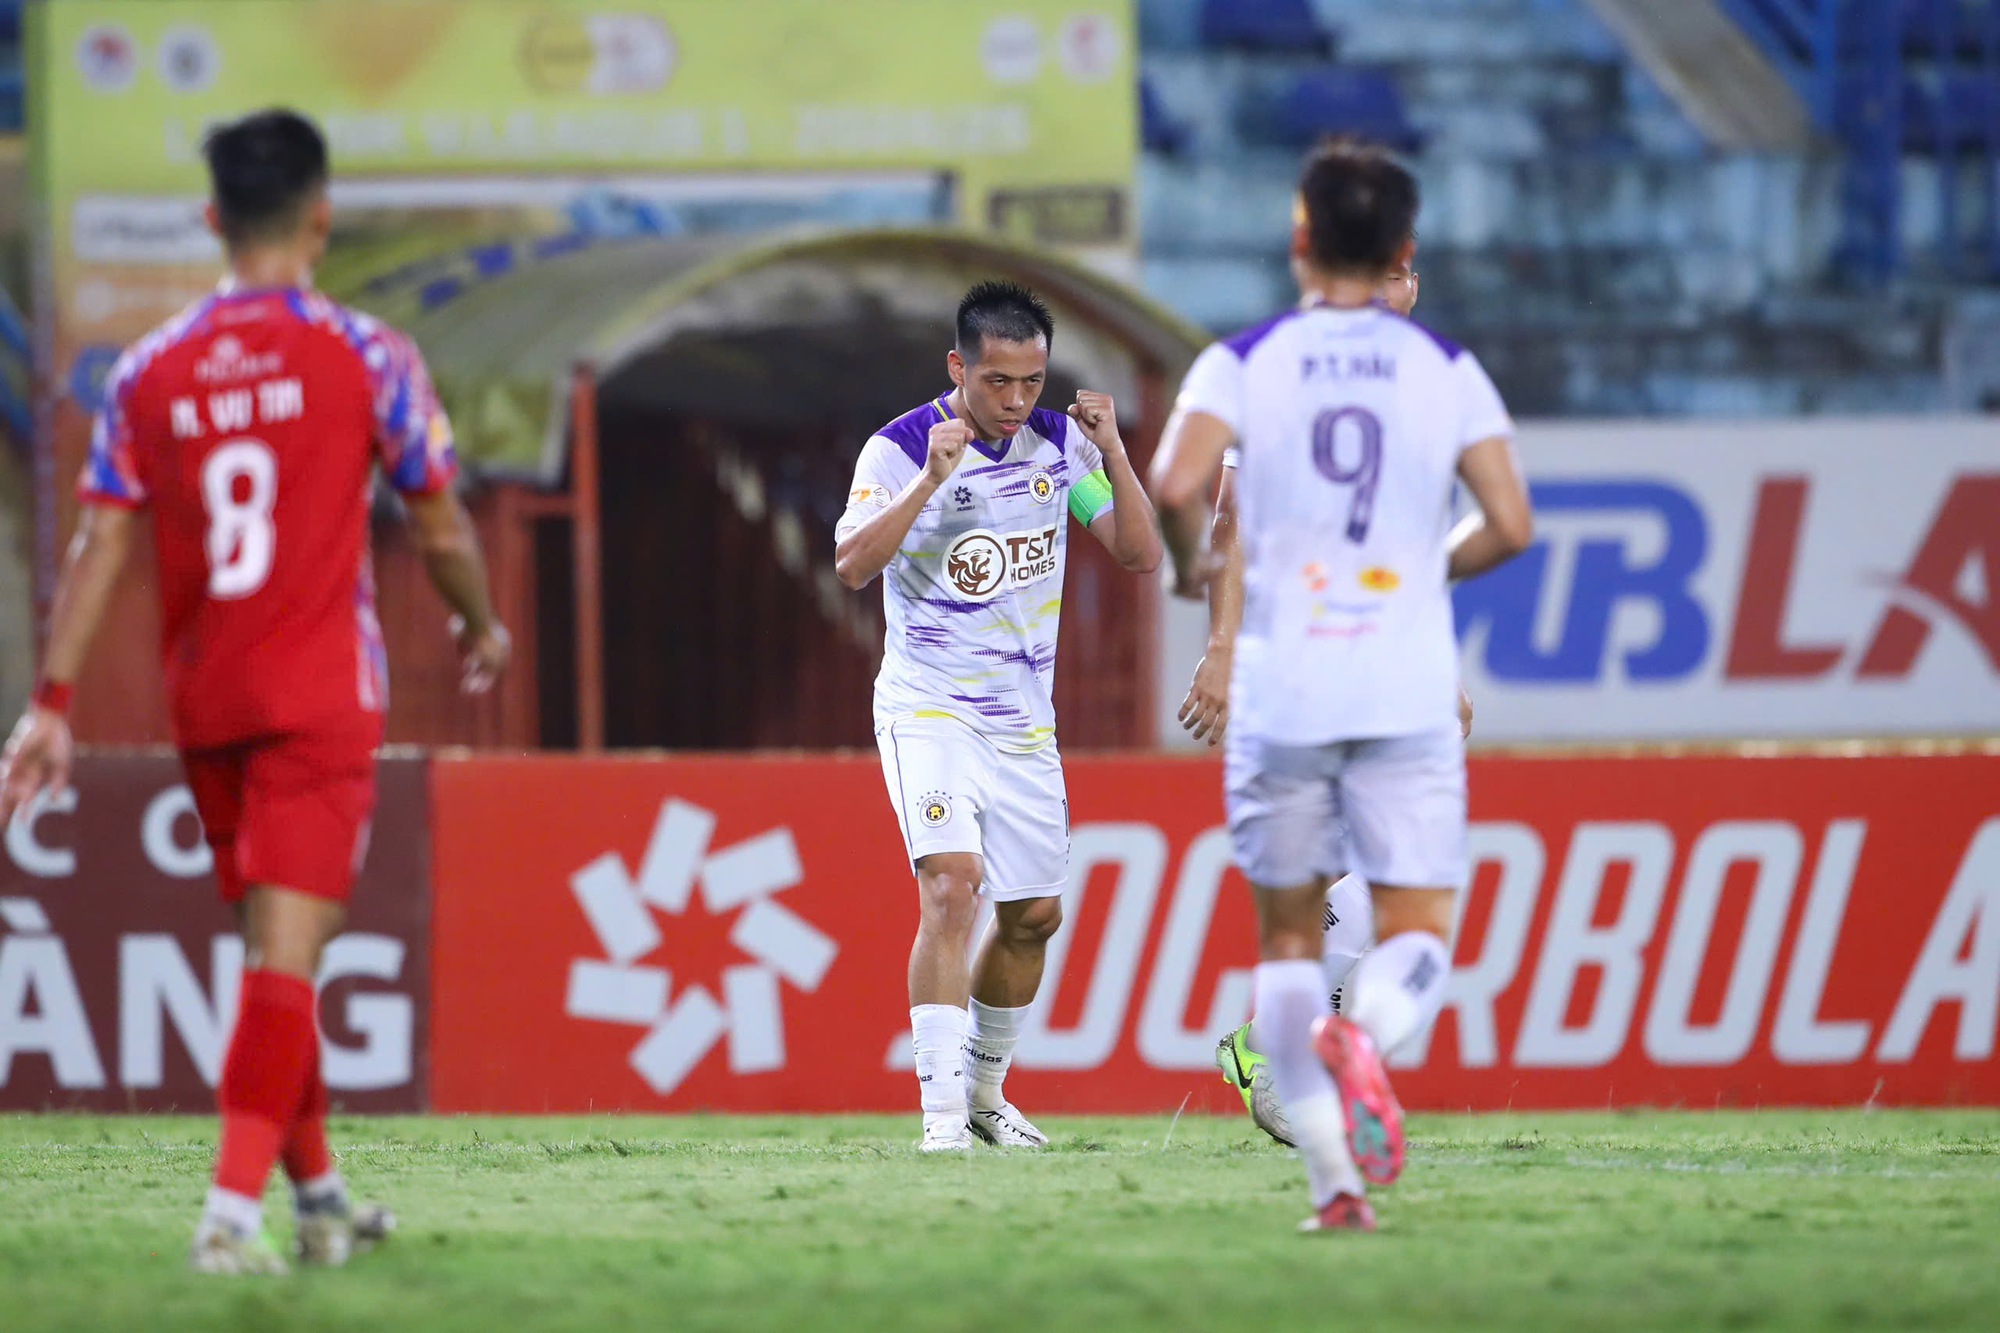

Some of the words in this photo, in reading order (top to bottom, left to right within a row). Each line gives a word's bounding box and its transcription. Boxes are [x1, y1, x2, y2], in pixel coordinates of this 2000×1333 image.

[202, 438, 278, 598] 8
[1312, 406, 1381, 545] 9
[1006, 528, 1057, 564] T&T
[1011, 556, 1055, 583] HOMES
